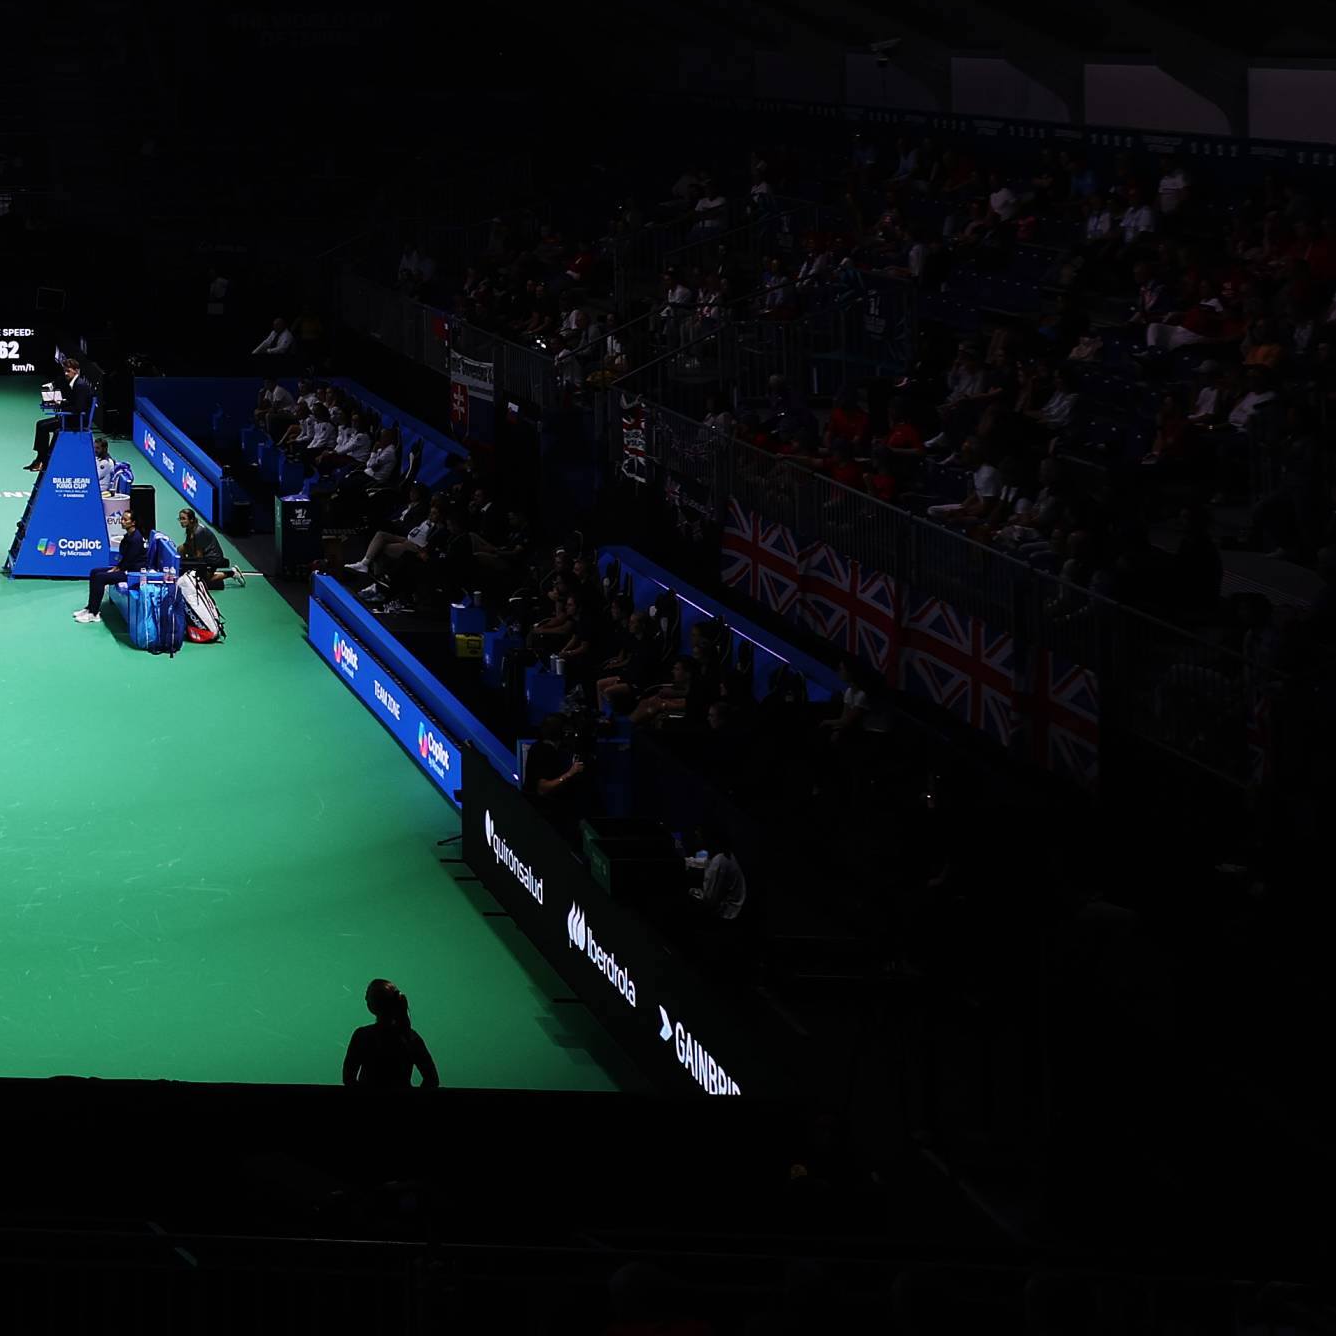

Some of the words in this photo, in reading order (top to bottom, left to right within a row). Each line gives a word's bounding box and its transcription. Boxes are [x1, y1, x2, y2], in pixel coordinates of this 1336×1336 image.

[59, 538, 101, 551] Copilot
[341, 640, 358, 670] Copilot
[374, 680, 387, 704] TEAM
[387, 691, 400, 720] ZONE
[428, 732, 449, 771] Copilot
[493, 834, 543, 905] quirónsalud
[587, 927, 636, 1008] Iberdrola
